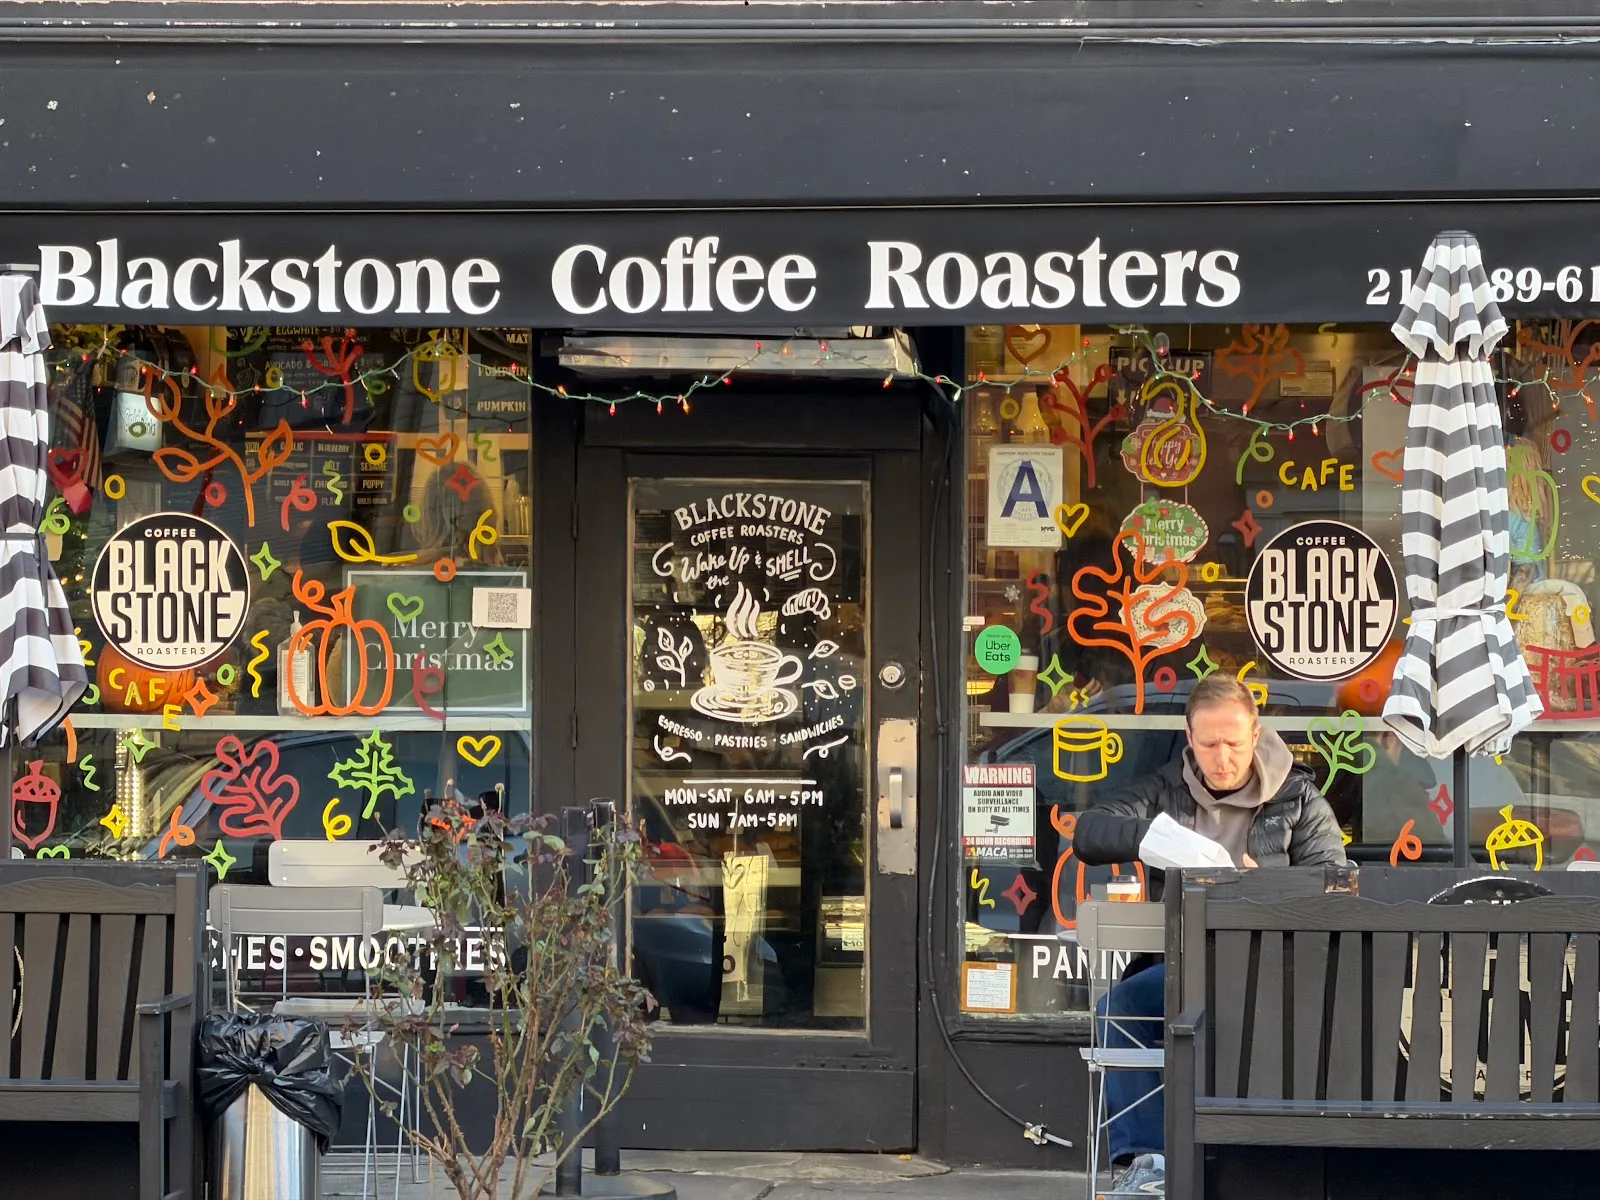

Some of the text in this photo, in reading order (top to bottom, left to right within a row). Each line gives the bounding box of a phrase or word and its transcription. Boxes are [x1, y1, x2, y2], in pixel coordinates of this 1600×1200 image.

[39, 236, 1241, 315] Blackstone Coffee Roasters
[478, 366, 528, 377] PUMPIN
[477, 401, 526, 412] PUMPKIN
[362, 479, 384, 489] POPPY
[1279, 458, 1355, 491] CAFE
[1000, 460, 1049, 518] A
[673, 493, 832, 536] BLACKSTONE
[144, 528, 196, 538] COFFEE
[691, 524, 805, 546] COFFEE ROASTERS
[1296, 536, 1346, 546] COFFEE
[110, 540, 231, 594] BLACK
[681, 552, 727, 583] Wake
[729, 546, 750, 574] Up
[706, 575, 730, 590] the
[1262, 548, 1381, 602] BLACK
[110, 592, 231, 644] STONE
[1264, 600, 1380, 653] STONE
[391, 615, 480, 648] Merry
[137, 647, 206, 655] ROASTERS
[985, 641, 1011, 650] Uber
[985, 651, 1011, 662] Eats
[1289, 657, 1355, 665] ROASTERS
[108, 667, 183, 731] CAFE
[658, 714, 844, 748] ESPRESSO PASTRIES SANDWICHES
[964, 765, 1032, 784] WARNING
[665, 788, 732, 806] MON-SAT
[744, 788, 775, 805] 6AM
[790, 790, 823, 807] 5PM
[973, 789, 1023, 797] AUDIO AND VIDEO
[688, 812, 798, 829] SUN 7AM-5PM
[966, 837, 1031, 845] 24 HOUR RECORDING
